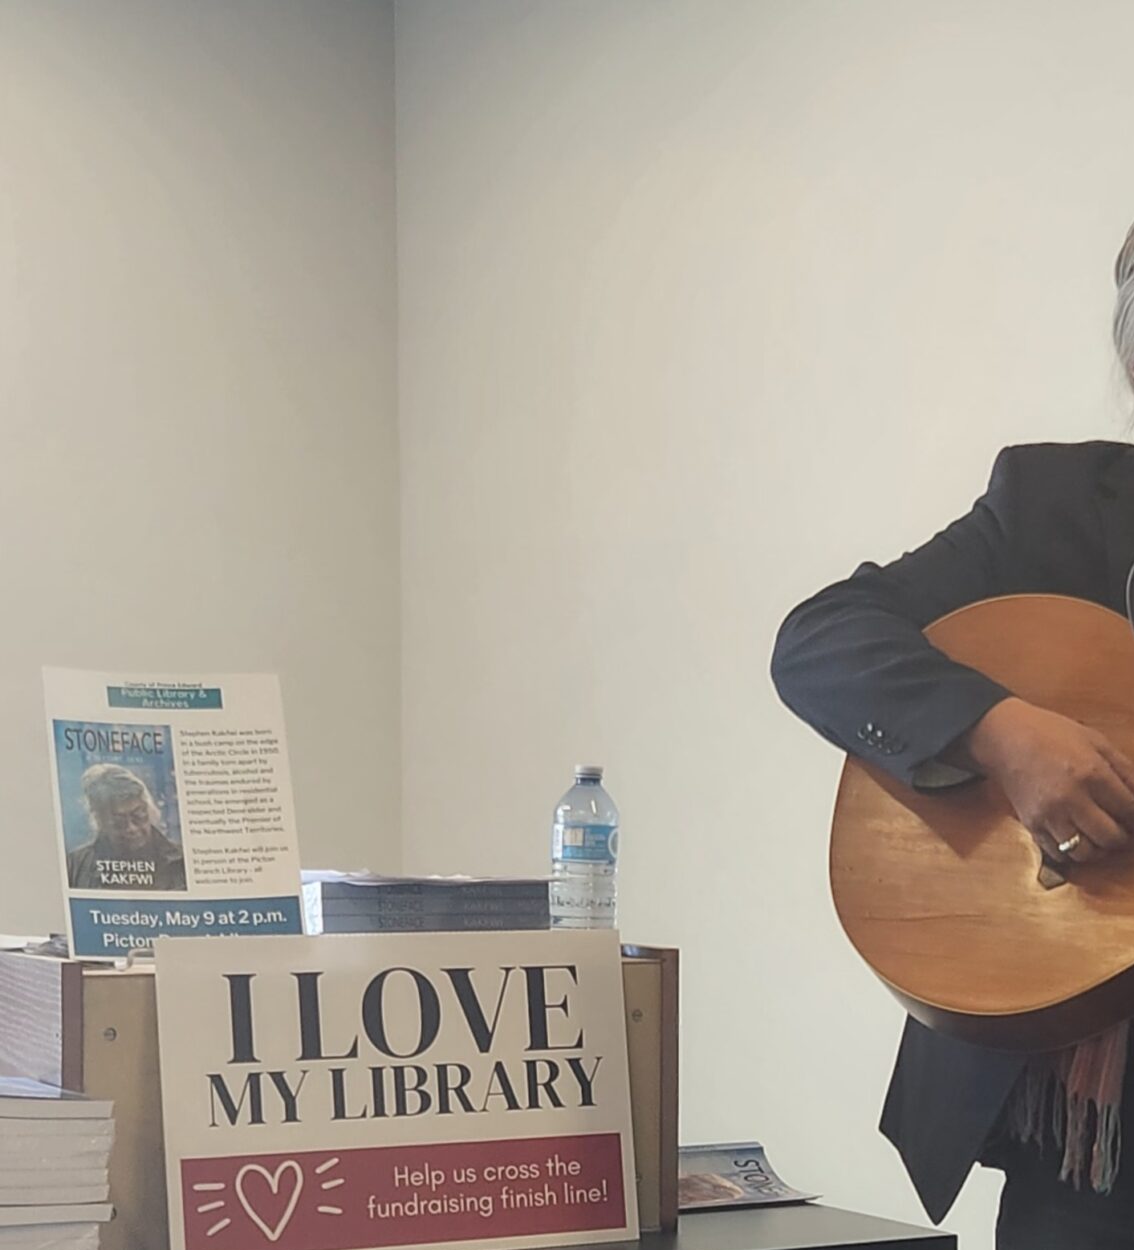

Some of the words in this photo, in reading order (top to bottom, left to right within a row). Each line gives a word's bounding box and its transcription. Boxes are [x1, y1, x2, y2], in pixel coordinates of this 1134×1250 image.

[120, 688, 155, 699] Public
[156, 689, 196, 700] Library
[198, 690, 207, 699] &
[141, 698, 190, 709] Archives
[64, 727, 164, 754] STONEFACE
[96, 860, 155, 872] STEPHEN
[100, 873, 153, 885] KAKFWI
[89, 909, 163, 928] Tuesday,
[166, 911, 200, 928] May
[203, 911, 215, 925] 9
[218, 912, 235, 925] at
[238, 910, 249, 925] 2
[252, 910, 287, 927] p.m.
[221, 973, 261, 1065] I
[290, 964, 584, 1062] LOVE
[206, 1069, 310, 1128] MY
[328, 1056, 604, 1122] LIBRARY
[393, 1164, 447, 1191] Help
[453, 1167, 477, 1185] us
[486, 1163, 541, 1183] cross
[545, 1155, 582, 1177] the
[367, 1190, 494, 1220] fundraising
[500, 1186, 558, 1210] finish
[563, 1180, 608, 1205] line!
